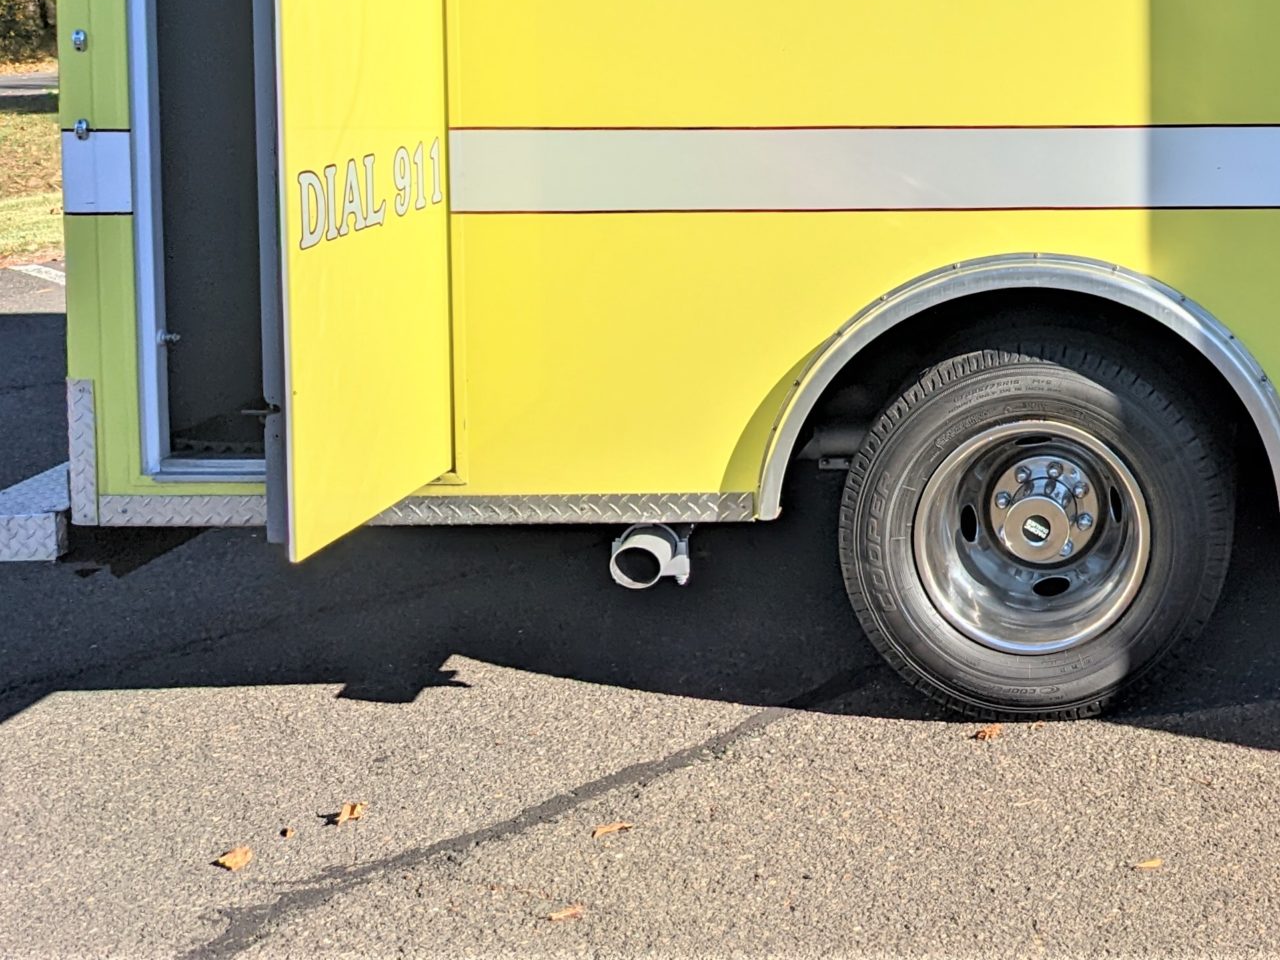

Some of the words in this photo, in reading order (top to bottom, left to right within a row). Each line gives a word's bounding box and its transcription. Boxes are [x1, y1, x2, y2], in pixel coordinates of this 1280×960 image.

[297, 153, 387, 251] DIAL
[393, 136, 443, 218] 911
[866, 471, 898, 612] COOPER
